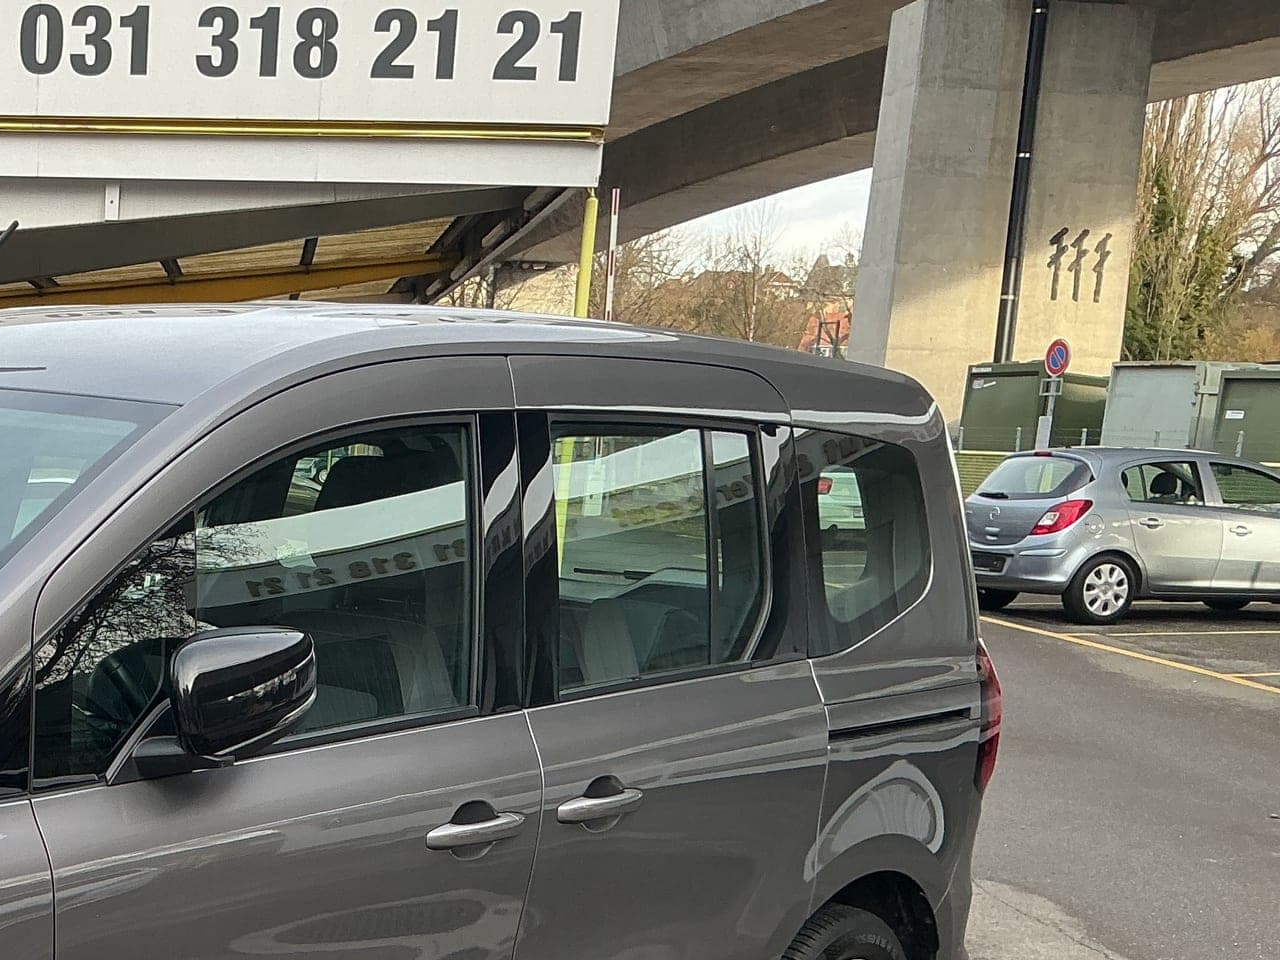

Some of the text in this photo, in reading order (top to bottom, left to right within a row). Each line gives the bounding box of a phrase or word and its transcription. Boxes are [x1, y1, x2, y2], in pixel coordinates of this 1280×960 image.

[20, 4, 152, 75] 031
[195, 6, 338, 79] 318
[370, 9, 460, 80] 21
[492, 10, 583, 82] 21
